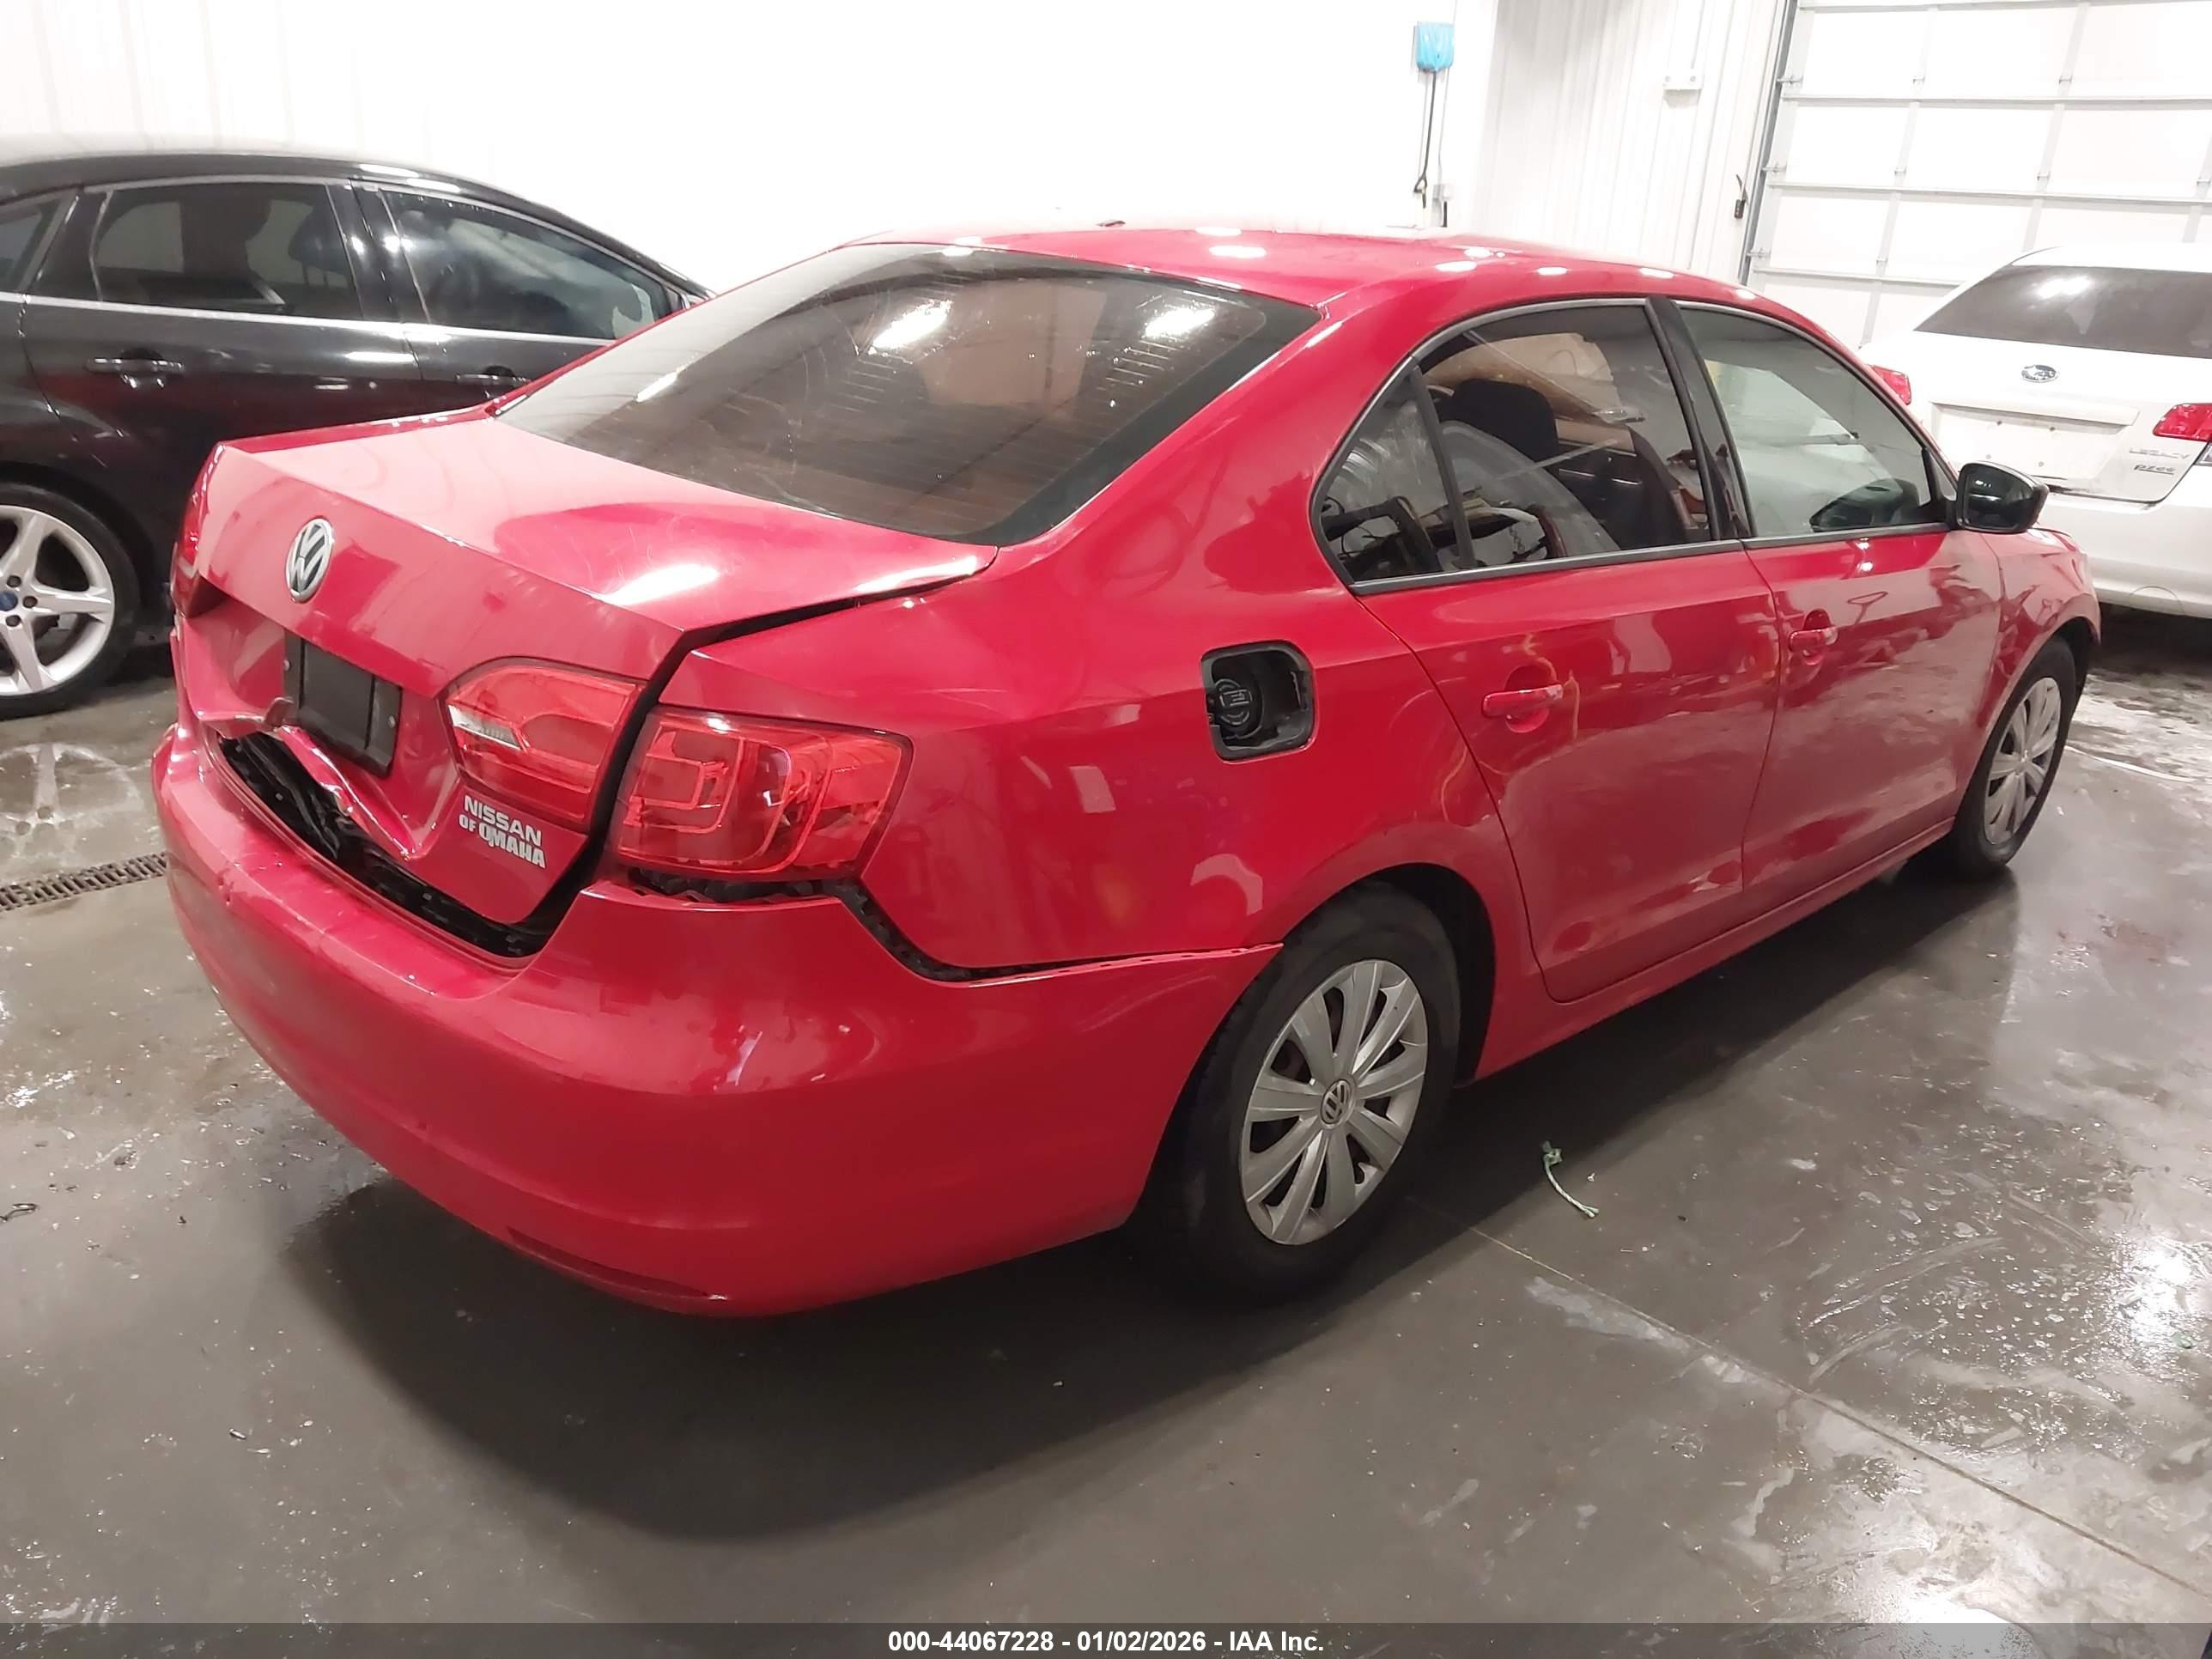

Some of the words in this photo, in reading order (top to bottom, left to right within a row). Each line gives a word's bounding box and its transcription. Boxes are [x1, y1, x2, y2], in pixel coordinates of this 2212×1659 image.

[459, 813, 477, 832] OF
[478, 822, 546, 869] OMAHA
[465, 794, 542, 847] NISSAN
